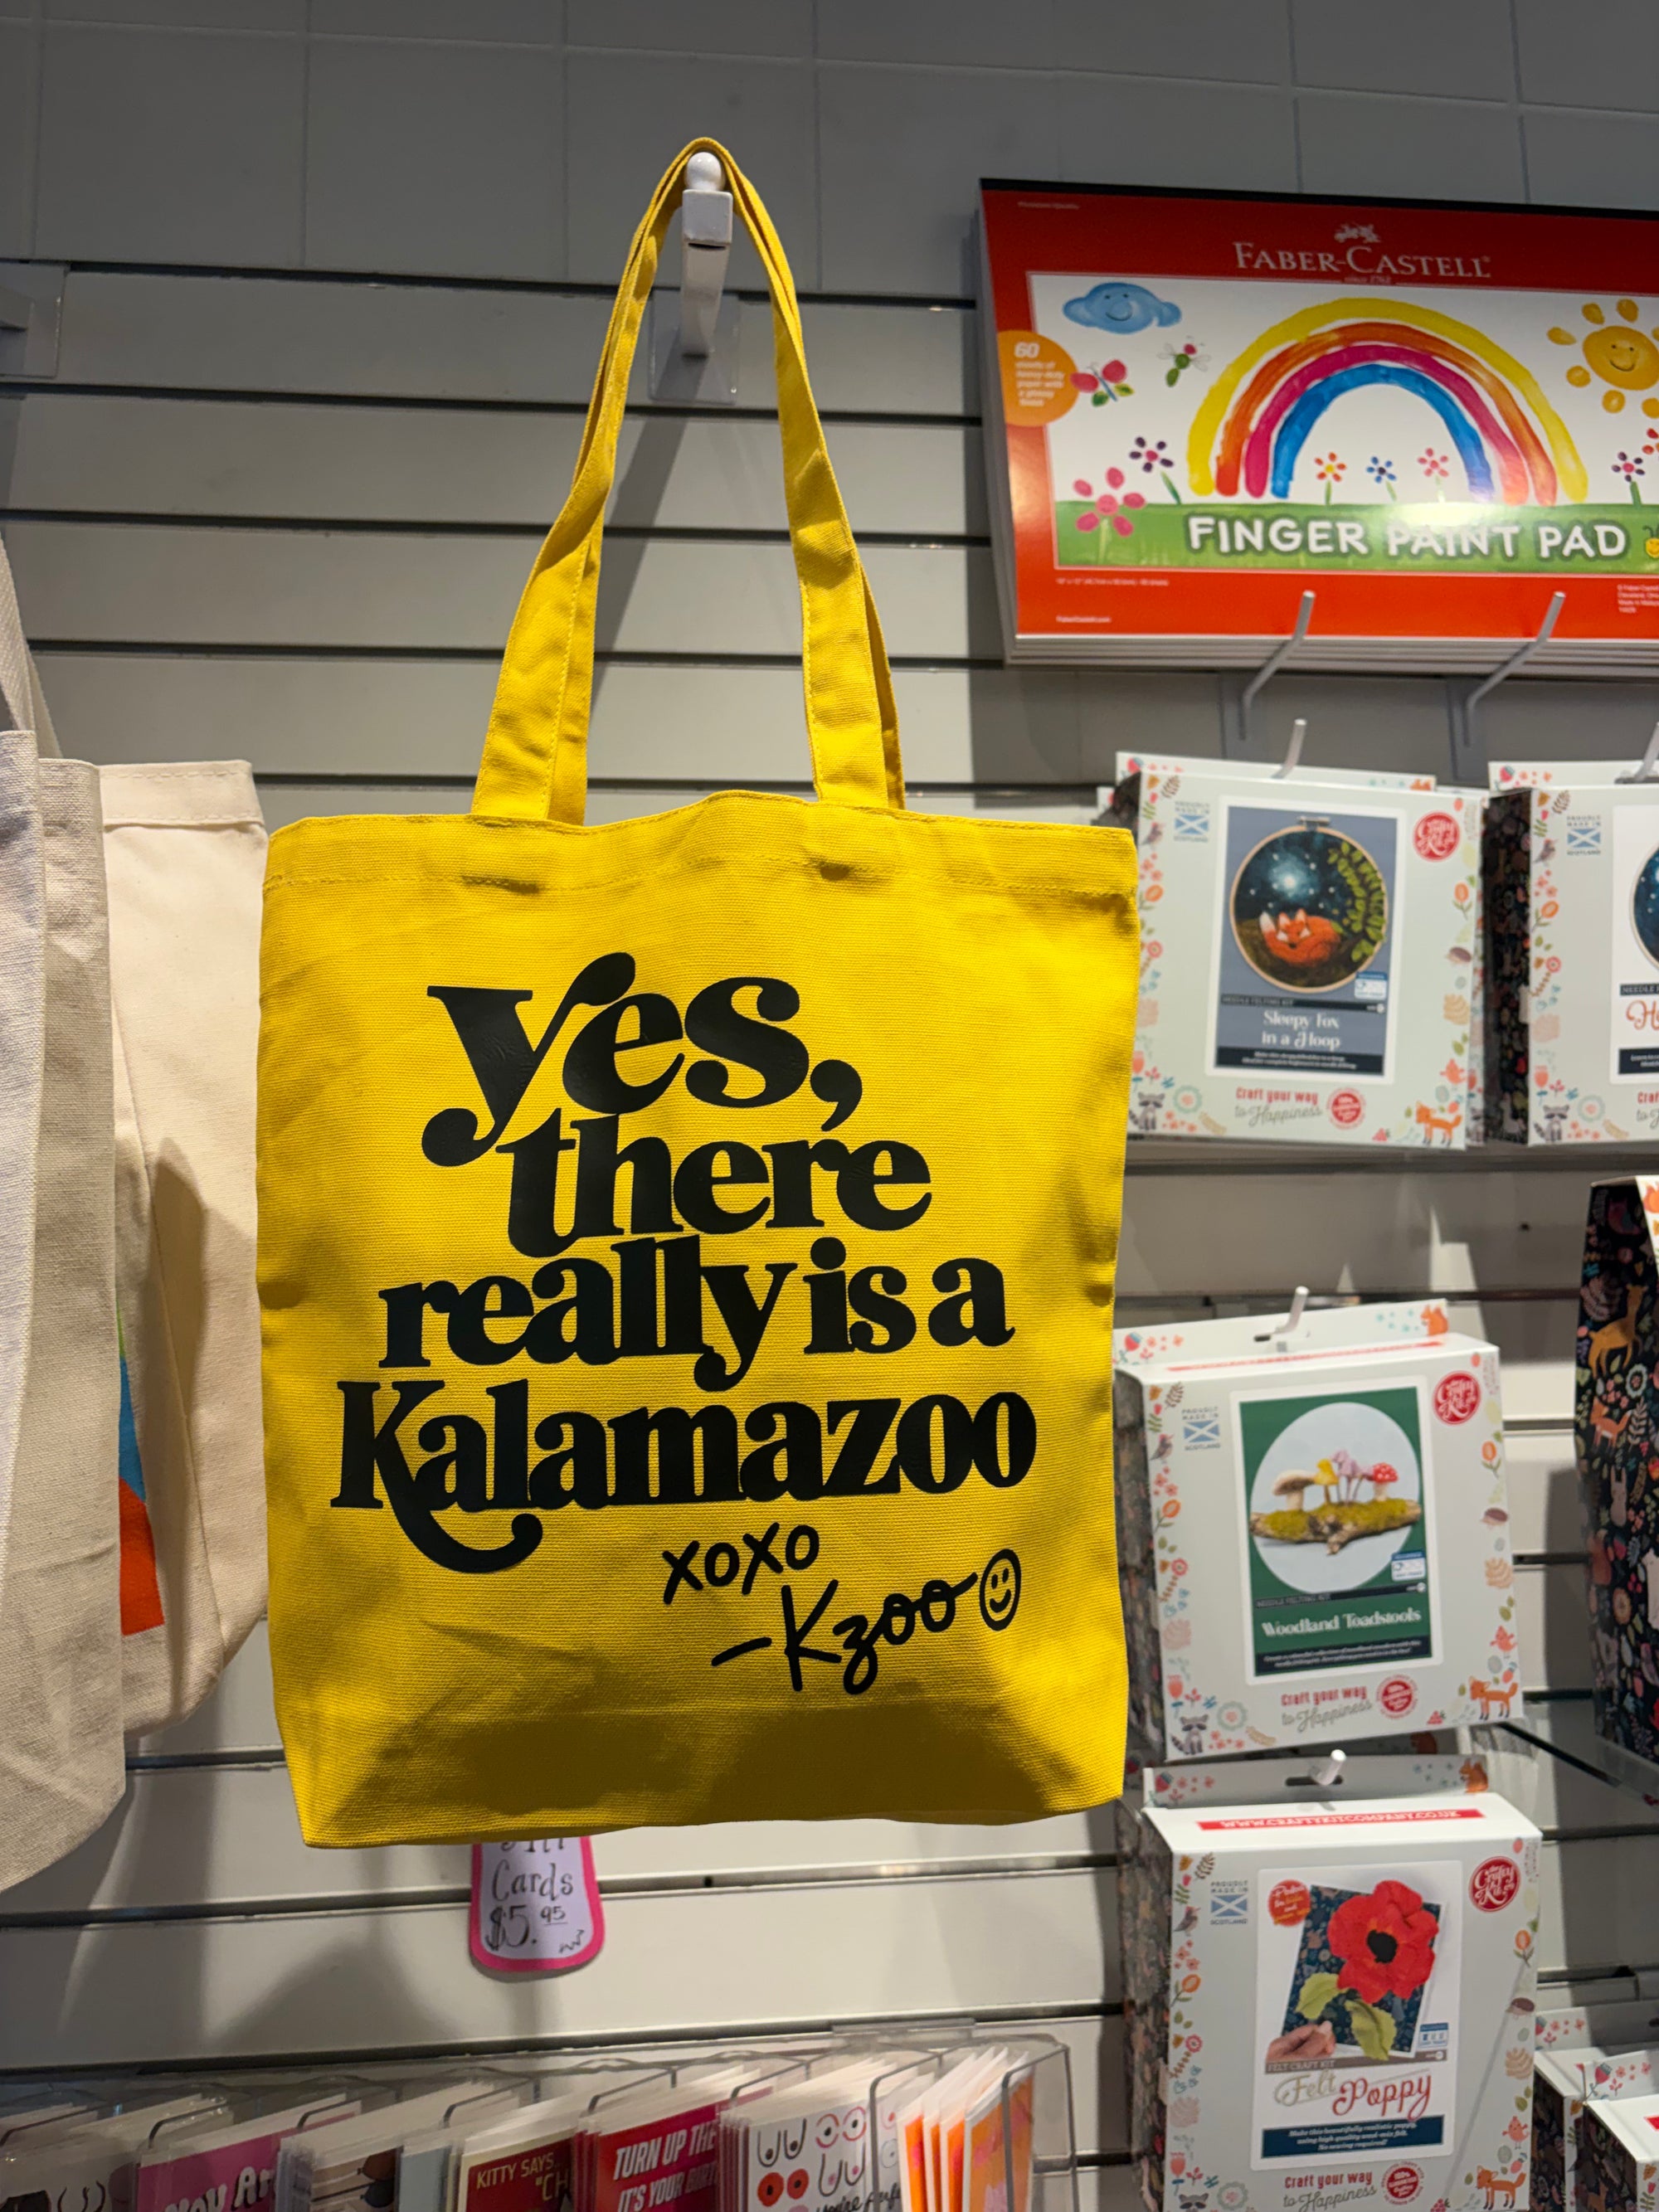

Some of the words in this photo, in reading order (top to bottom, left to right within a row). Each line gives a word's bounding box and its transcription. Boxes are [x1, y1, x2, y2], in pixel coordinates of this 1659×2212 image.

[1233, 241, 1491, 279] FABER-CASTELL
[1014, 341, 1040, 359] 60
[1188, 516, 1369, 556] FINGER
[1388, 525, 1520, 557] PAINT
[1540, 524, 1627, 557] PAD
[1262, 1009, 1309, 1030] Sleepy
[496, 1107, 932, 1258] there
[378, 1233, 798, 1392] really
[802, 1237, 917, 1354] is
[928, 1257, 1015, 1347] a
[330, 1378, 1038, 1574] Kalamazoo
[1261, 1615, 1340, 1637] Woodland
[1342, 1607, 1422, 1629] Toadstools
[492, 1860, 574, 1902] Cards
[1267, 2064, 1288, 2073] FELT
[1289, 2061, 1319, 2071] CRAFT
[1320, 2059, 1336, 2069] KIT
[1274, 2069, 1337, 2107] Felt
[1332, 2073, 1433, 2122] Poppy
[613, 2136, 663, 2181] TURN
[662, 2128, 688, 2166] UP
[688, 2120, 718, 2157] THE
[476, 2162, 518, 2190] KITTY
[1285, 2175, 1315, 2189] Craft
[1317, 2172, 1345, 2190] your
[1347, 2171, 1373, 2186] way
[1298, 2185, 1378, 2212] Happiness
